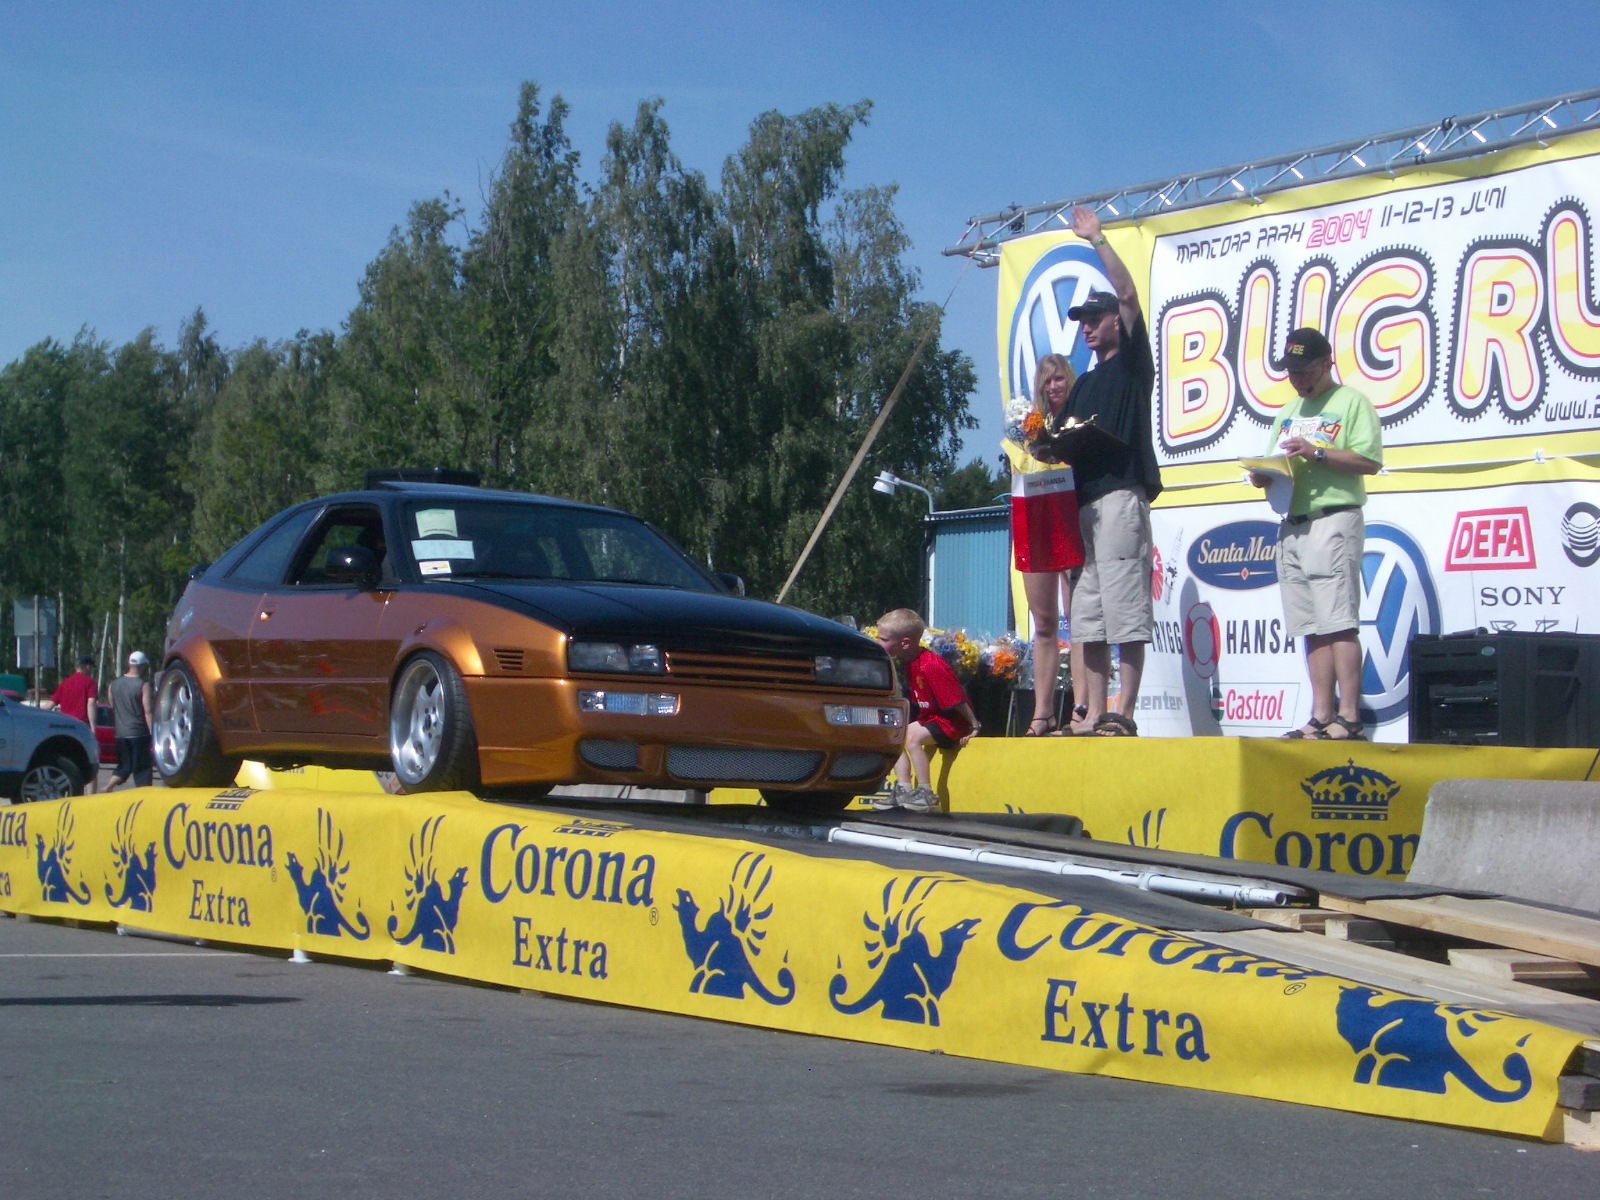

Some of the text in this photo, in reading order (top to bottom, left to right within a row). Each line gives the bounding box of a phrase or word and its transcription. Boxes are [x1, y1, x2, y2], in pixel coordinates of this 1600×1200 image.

[1256, 221, 1305, 249] PARK
[1306, 207, 1373, 250] 2004
[1380, 195, 1455, 228] 11-12-13
[1460, 185, 1507, 216] JUNI
[1158, 245, 1439, 457] BUG
[1198, 538, 1244, 564] Santa
[1454, 518, 1525, 559] DEFA
[1480, 586, 1566, 607] SONY
[1226, 618, 1296, 655] HANSA
[1226, 688, 1284, 721] Castrol
[163, 802, 273, 870] Corona
[480, 822, 656, 908] Corona
[188, 879, 251, 928] Extra
[512, 915, 608, 981] Extra
[1041, 977, 1211, 1063] Extra
